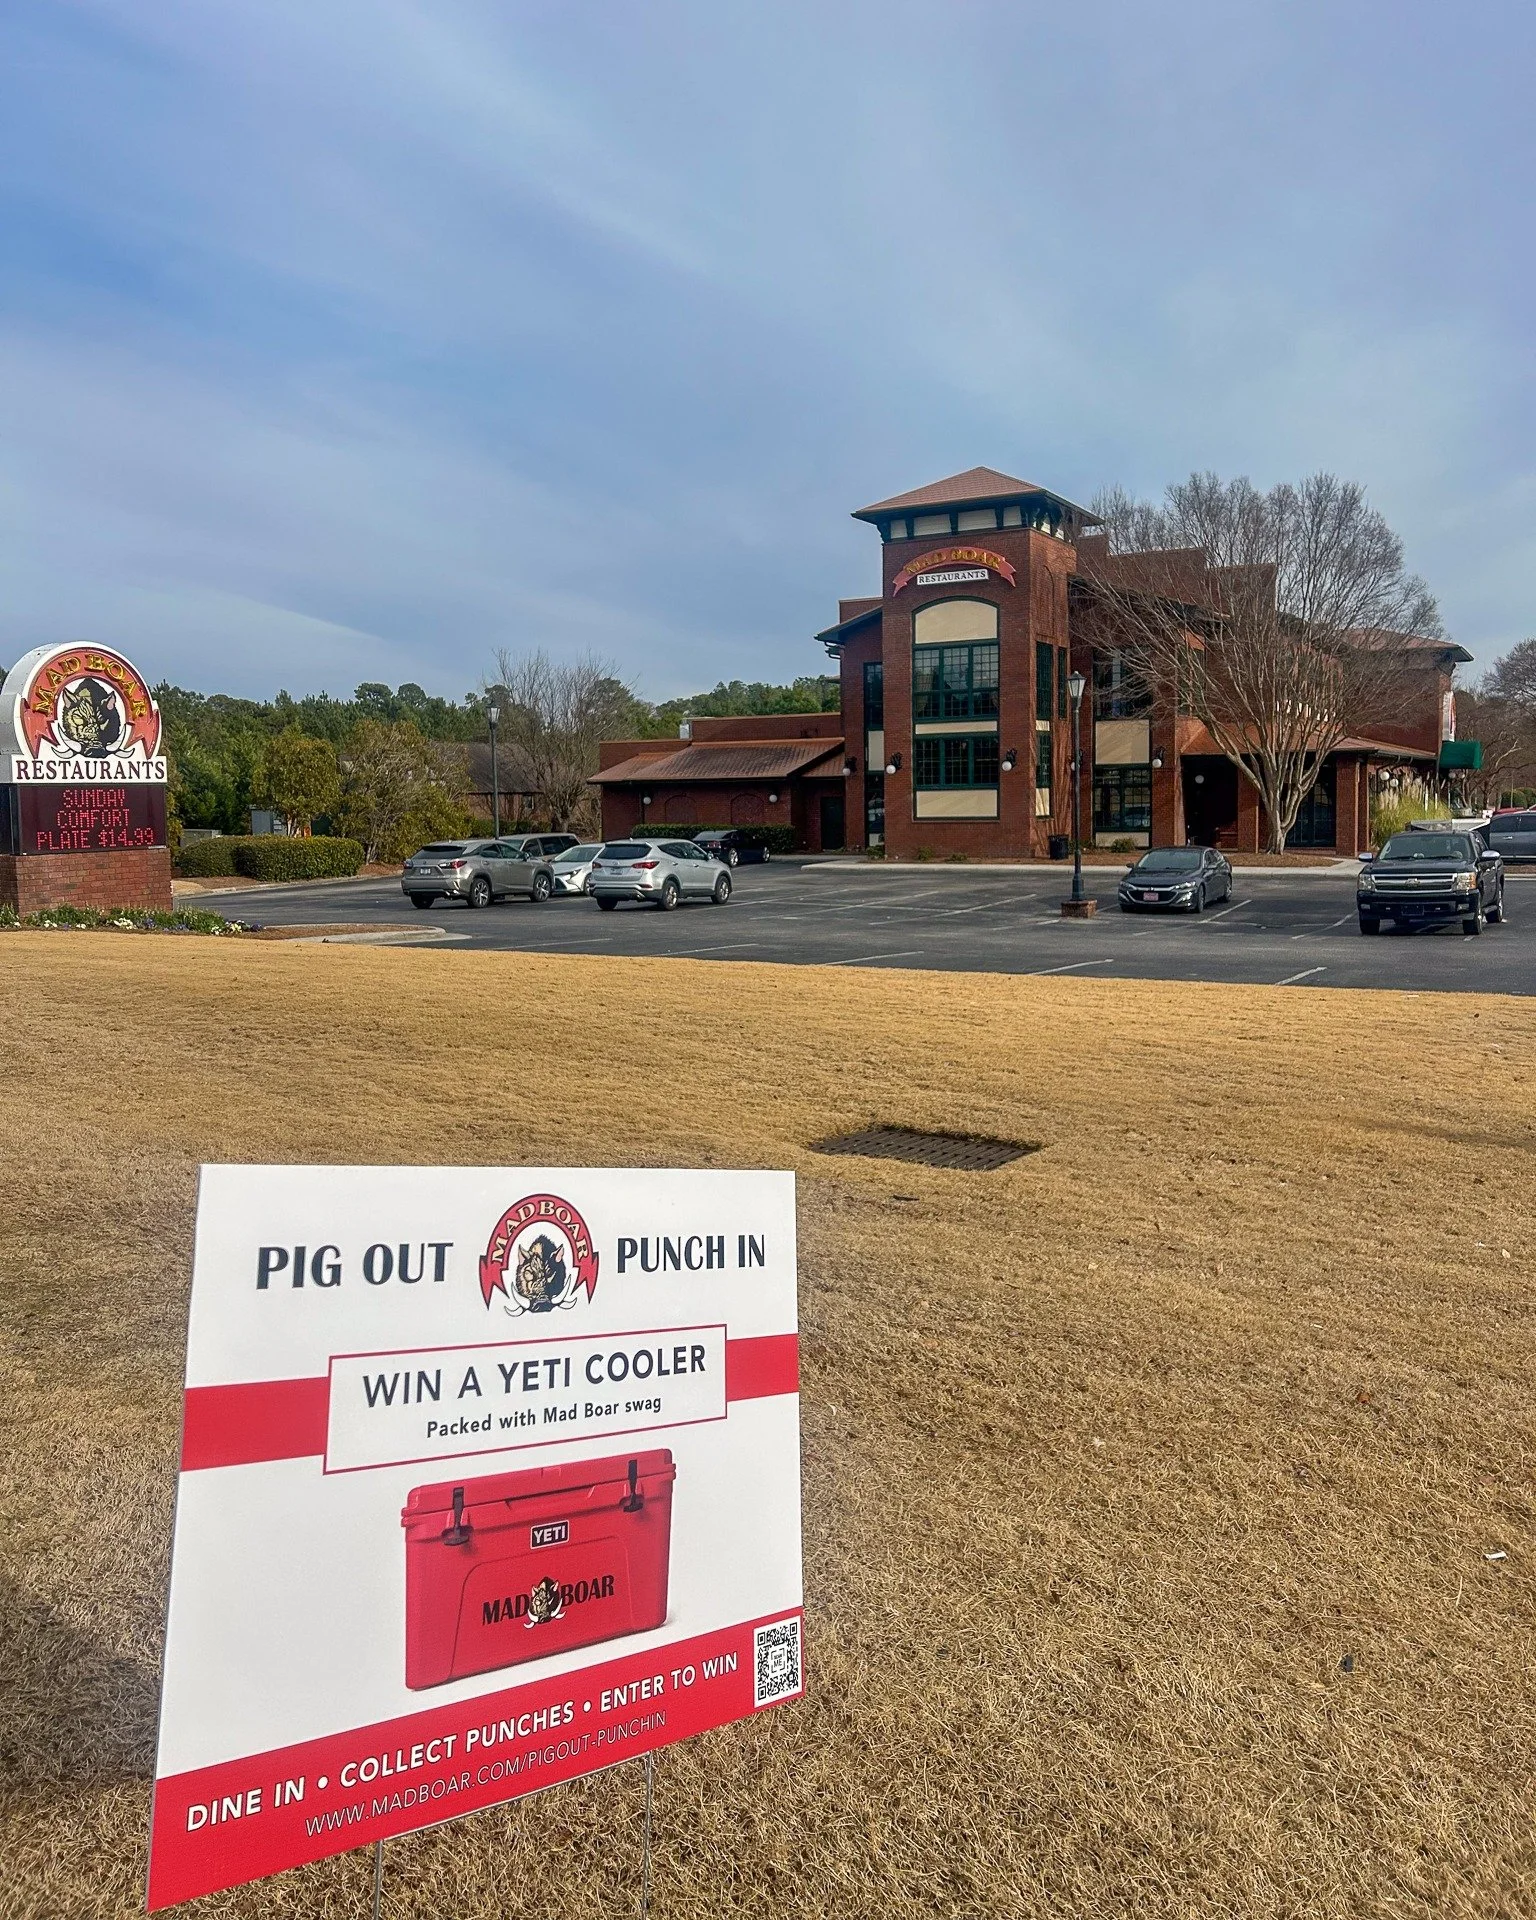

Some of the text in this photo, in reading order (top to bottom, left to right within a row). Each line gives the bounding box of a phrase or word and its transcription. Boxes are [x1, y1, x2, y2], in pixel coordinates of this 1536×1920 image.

[905, 548, 1000, 573] MAD BOAR
[918, 570, 986, 583] RESTAURANTS
[33, 653, 147, 720] MAD BOAR
[16, 760, 165, 780] RESTAURANTS
[62, 788, 126, 808] SUNDAY
[36, 827, 154, 850] PLATE $14.99
[57, 808, 130, 829] COMFORT
[491, 1200, 589, 1263] MAD BOAR
[256, 1242, 454, 1290] PIG OUT
[617, 1234, 765, 1273] PUNCH IN
[363, 1344, 706, 1408] WIN A YETI COOLER
[427, 1397, 661, 1438] Packed with Mad Boar swag
[533, 1525, 567, 1546] YETI
[482, 1574, 615, 1626] MAD BOAR
[186, 1651, 738, 1833] DINE IN COLLECT PUNCHES ENTER TO WIN
[304, 1710, 667, 1837] WWW.MADBOAR.COM/PIGOUT-PUNCHIN
